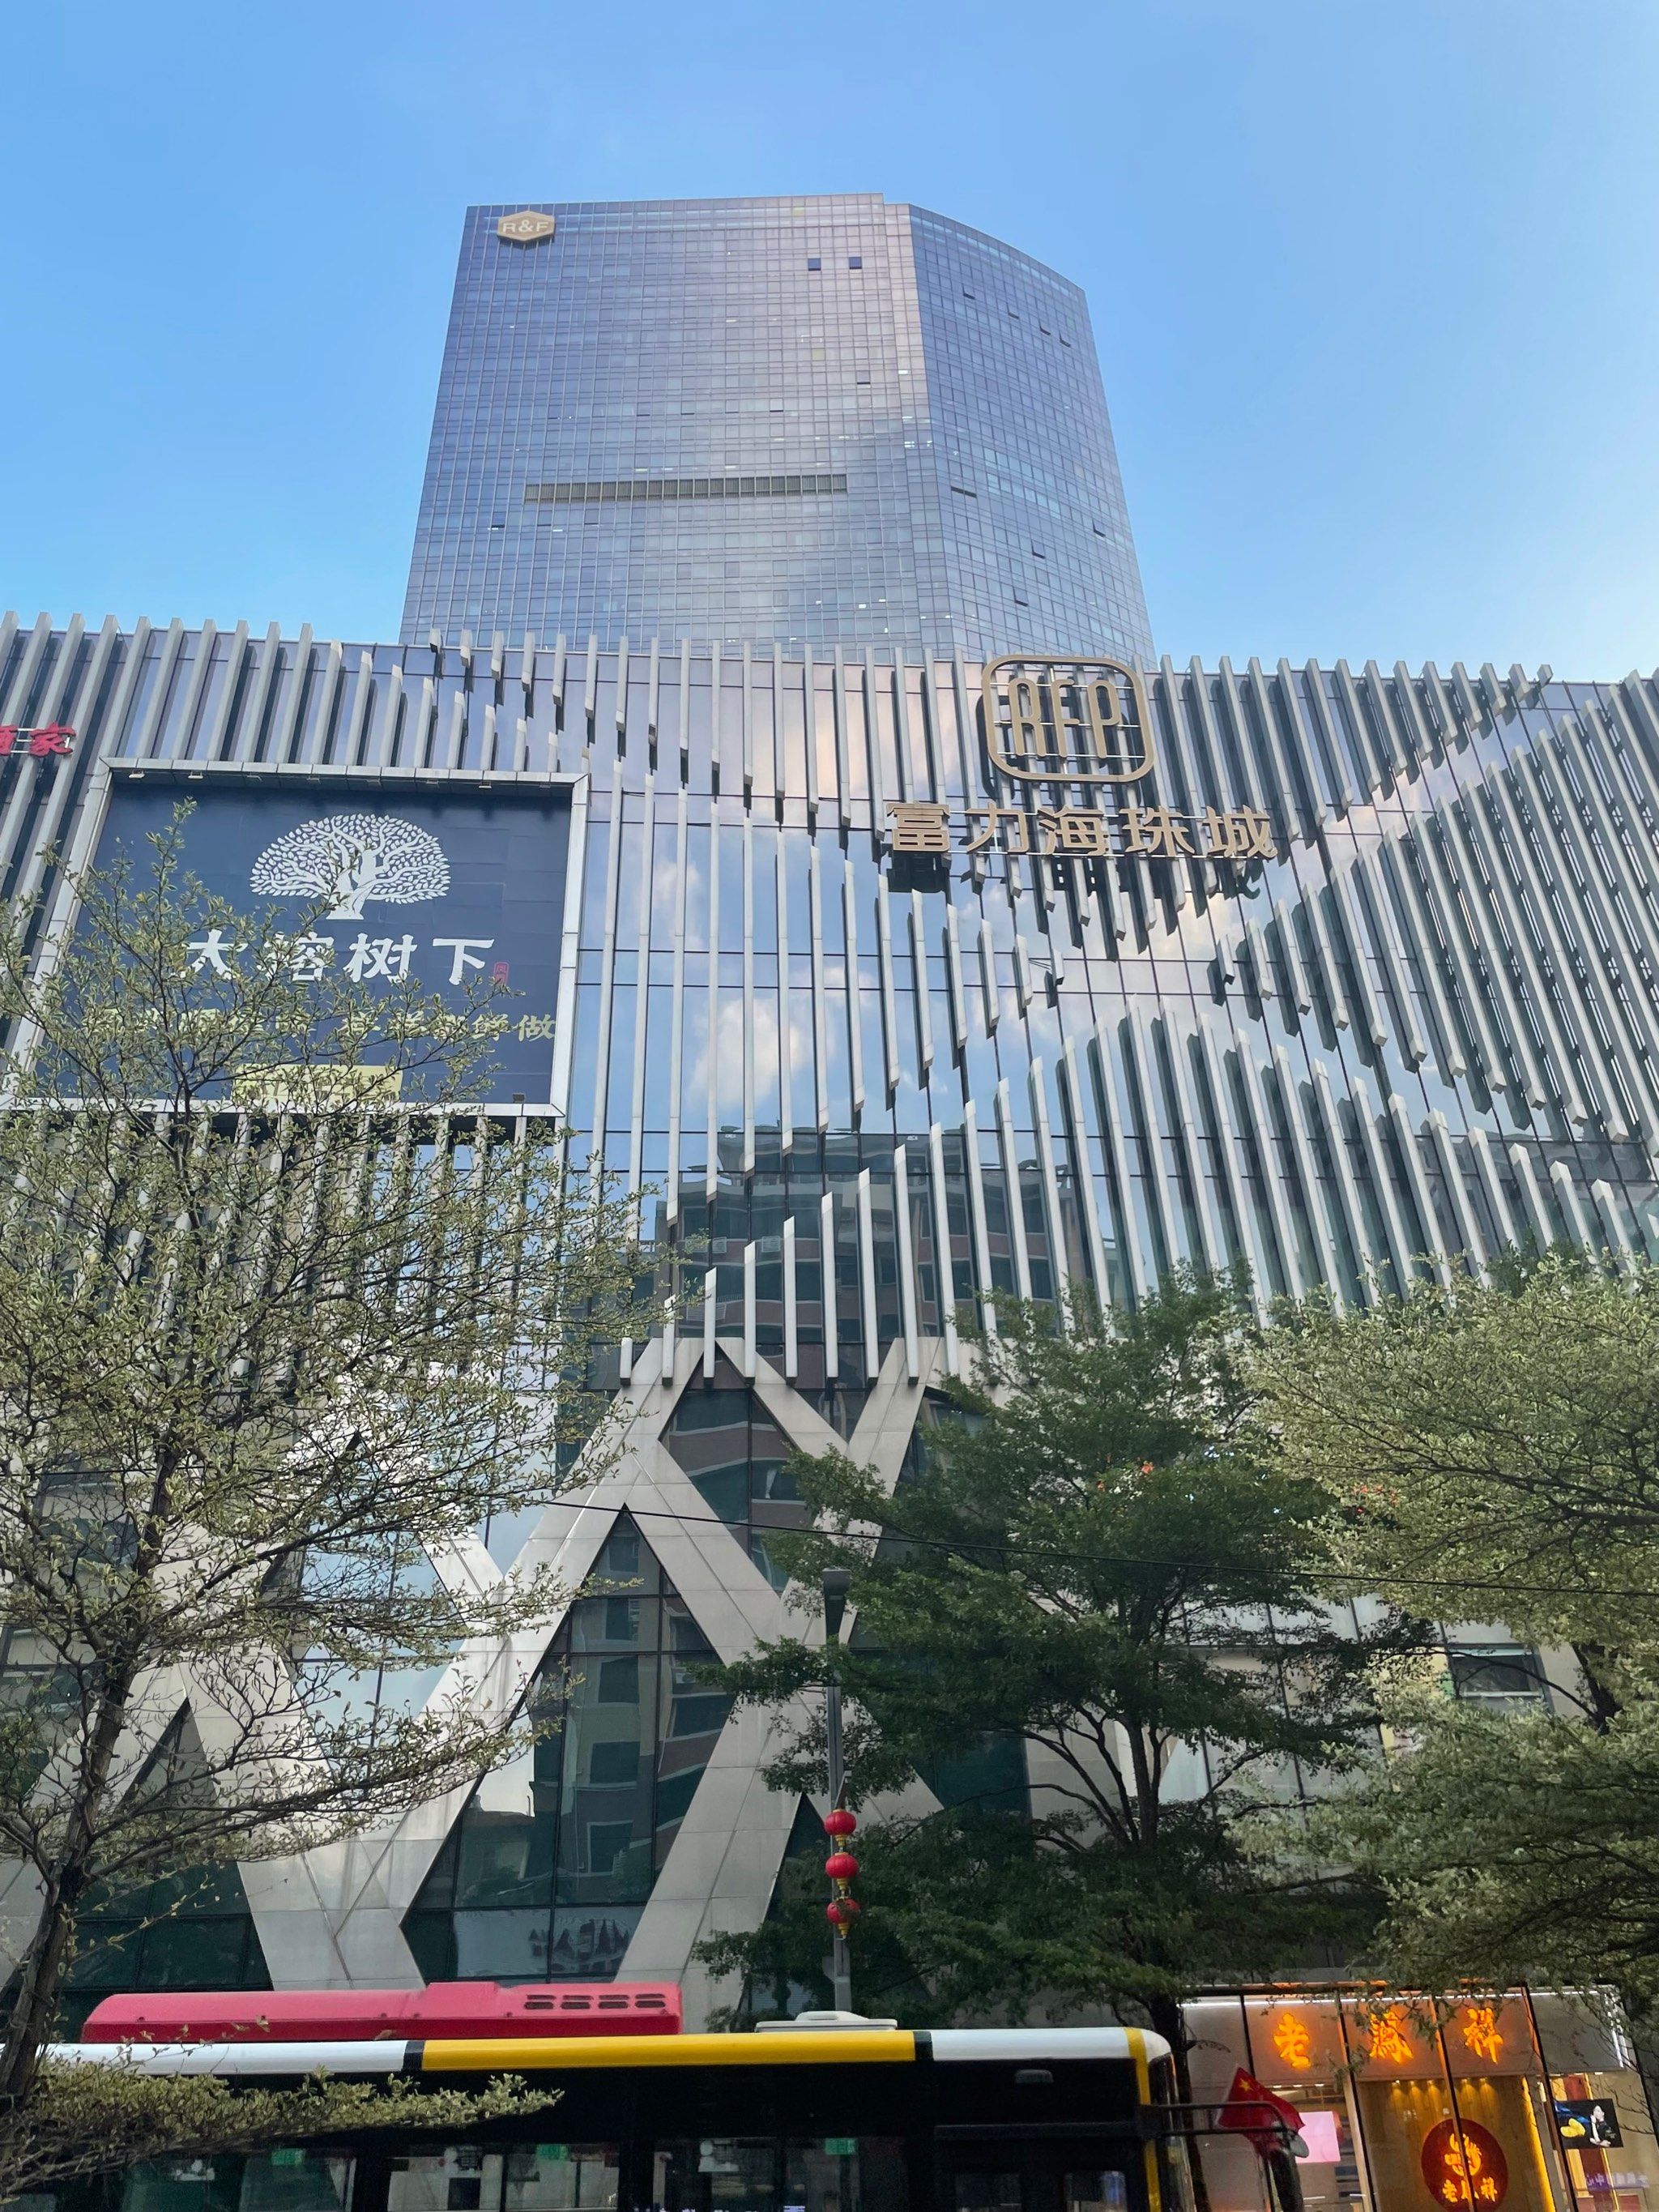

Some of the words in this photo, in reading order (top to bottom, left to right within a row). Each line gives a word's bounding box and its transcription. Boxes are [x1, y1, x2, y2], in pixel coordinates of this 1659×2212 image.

[502, 220, 549, 233] R&F
[1008, 678, 1121, 759] RFP
[887, 801, 1278, 860] 富力海珠城
[180, 929, 495, 985] 大榕树下
